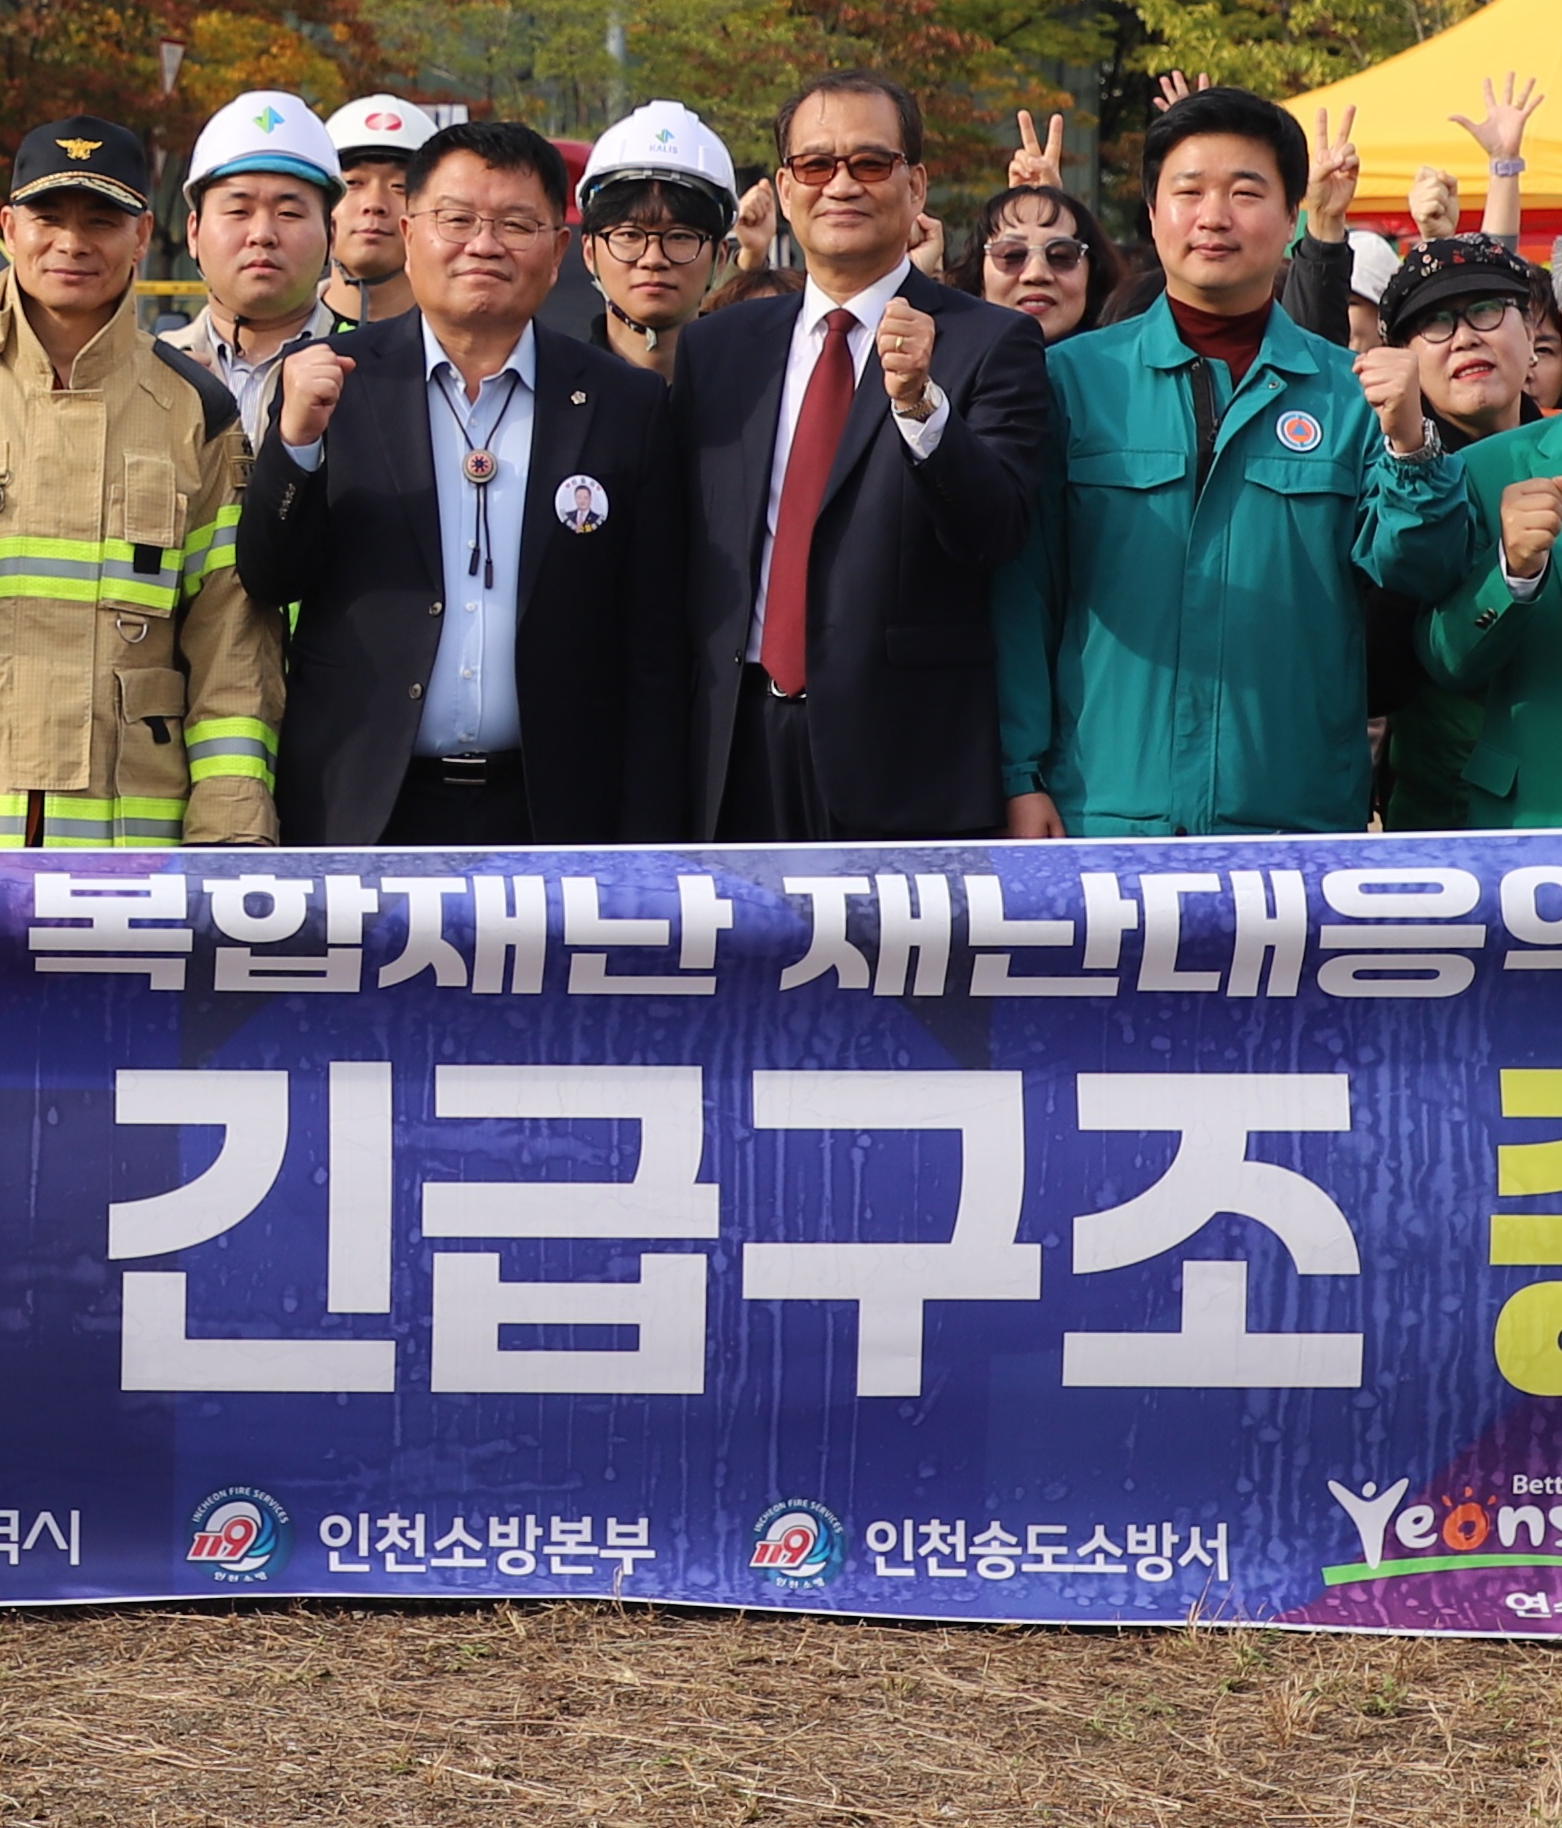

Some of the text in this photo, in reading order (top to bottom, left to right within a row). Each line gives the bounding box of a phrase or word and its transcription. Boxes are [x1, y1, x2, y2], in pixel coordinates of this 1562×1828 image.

[649, 144, 679, 155] KALIS
[26, 871, 736, 998] 복합재난
[107, 1060, 1366, 1399] 긴급구조
[192, 1486, 289, 1524] INCHEON FIRE SERVICES
[787, 1498, 809, 1508] FIRE
[187, 1515, 258, 1561] 119
[318, 1511, 657, 1576] 인천소방본부
[749, 1526, 815, 1568] 119
[865, 1518, 1230, 1584] 인천송도소방서
